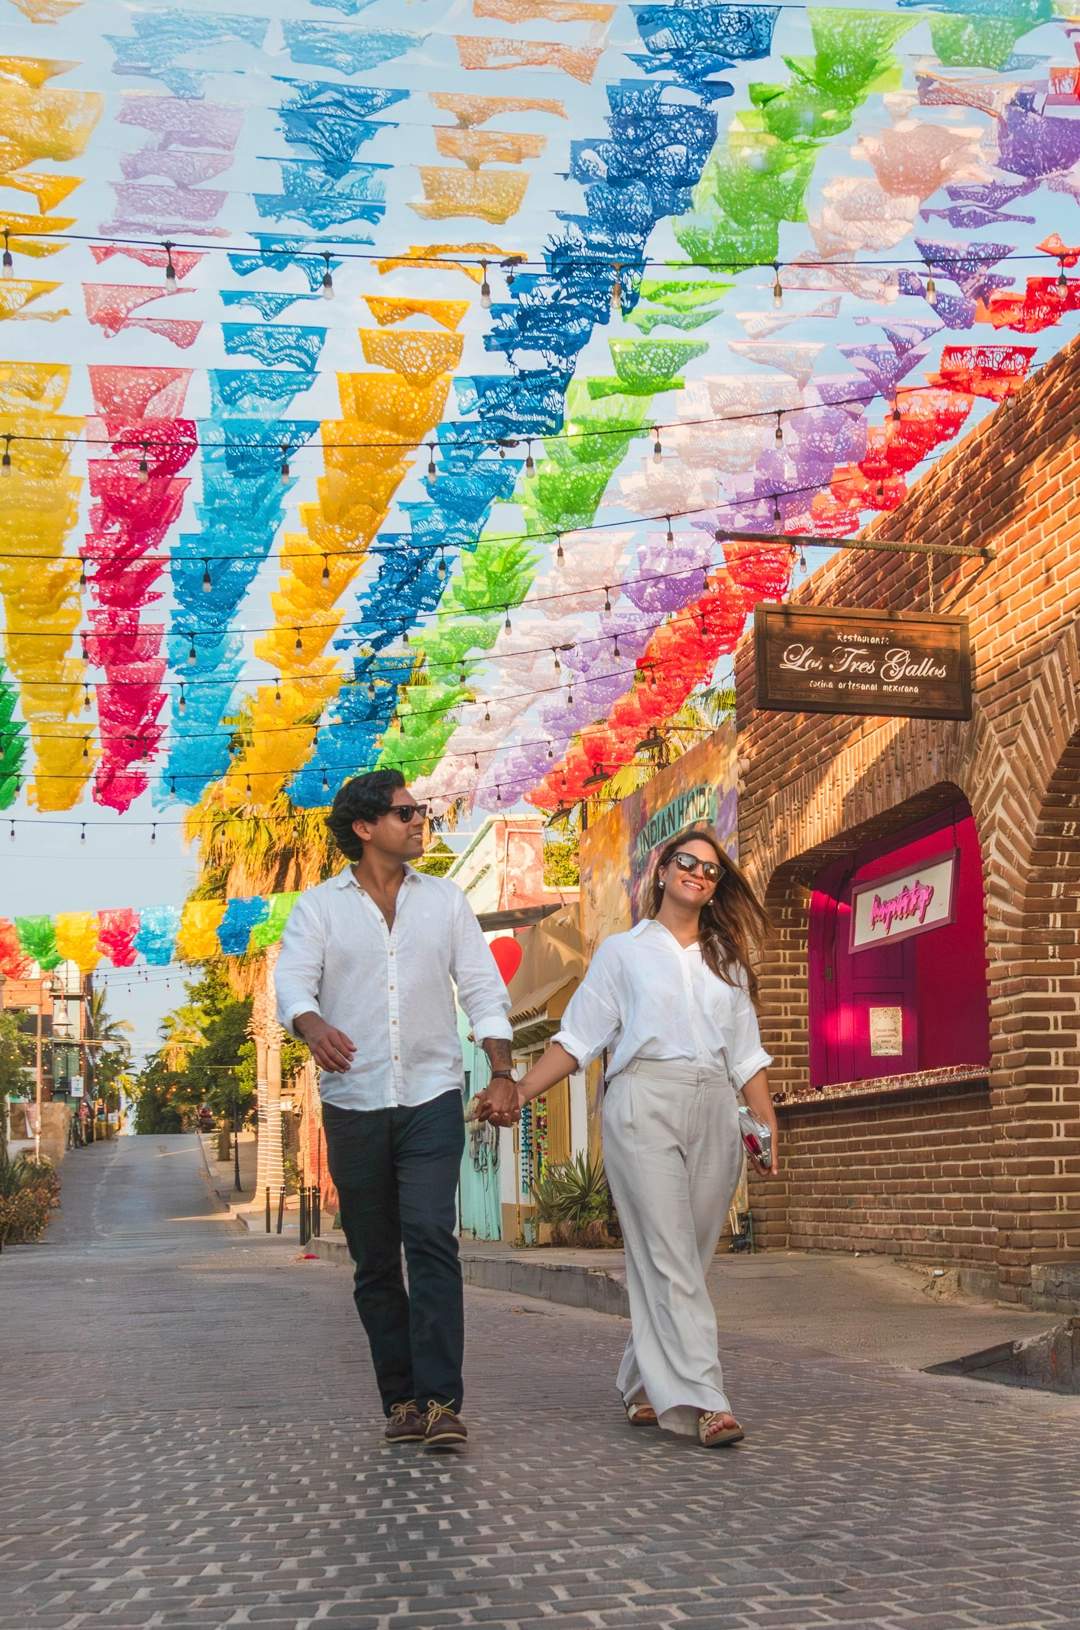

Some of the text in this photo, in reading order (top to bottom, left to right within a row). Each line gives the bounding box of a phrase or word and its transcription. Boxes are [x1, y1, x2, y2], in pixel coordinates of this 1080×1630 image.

[829, 646, 876, 675] Tres
[880, 648, 947, 682] Gallos
[809, 679, 920, 694] cocina artesanal mexicana
[639, 803, 675, 855] INDIAN
